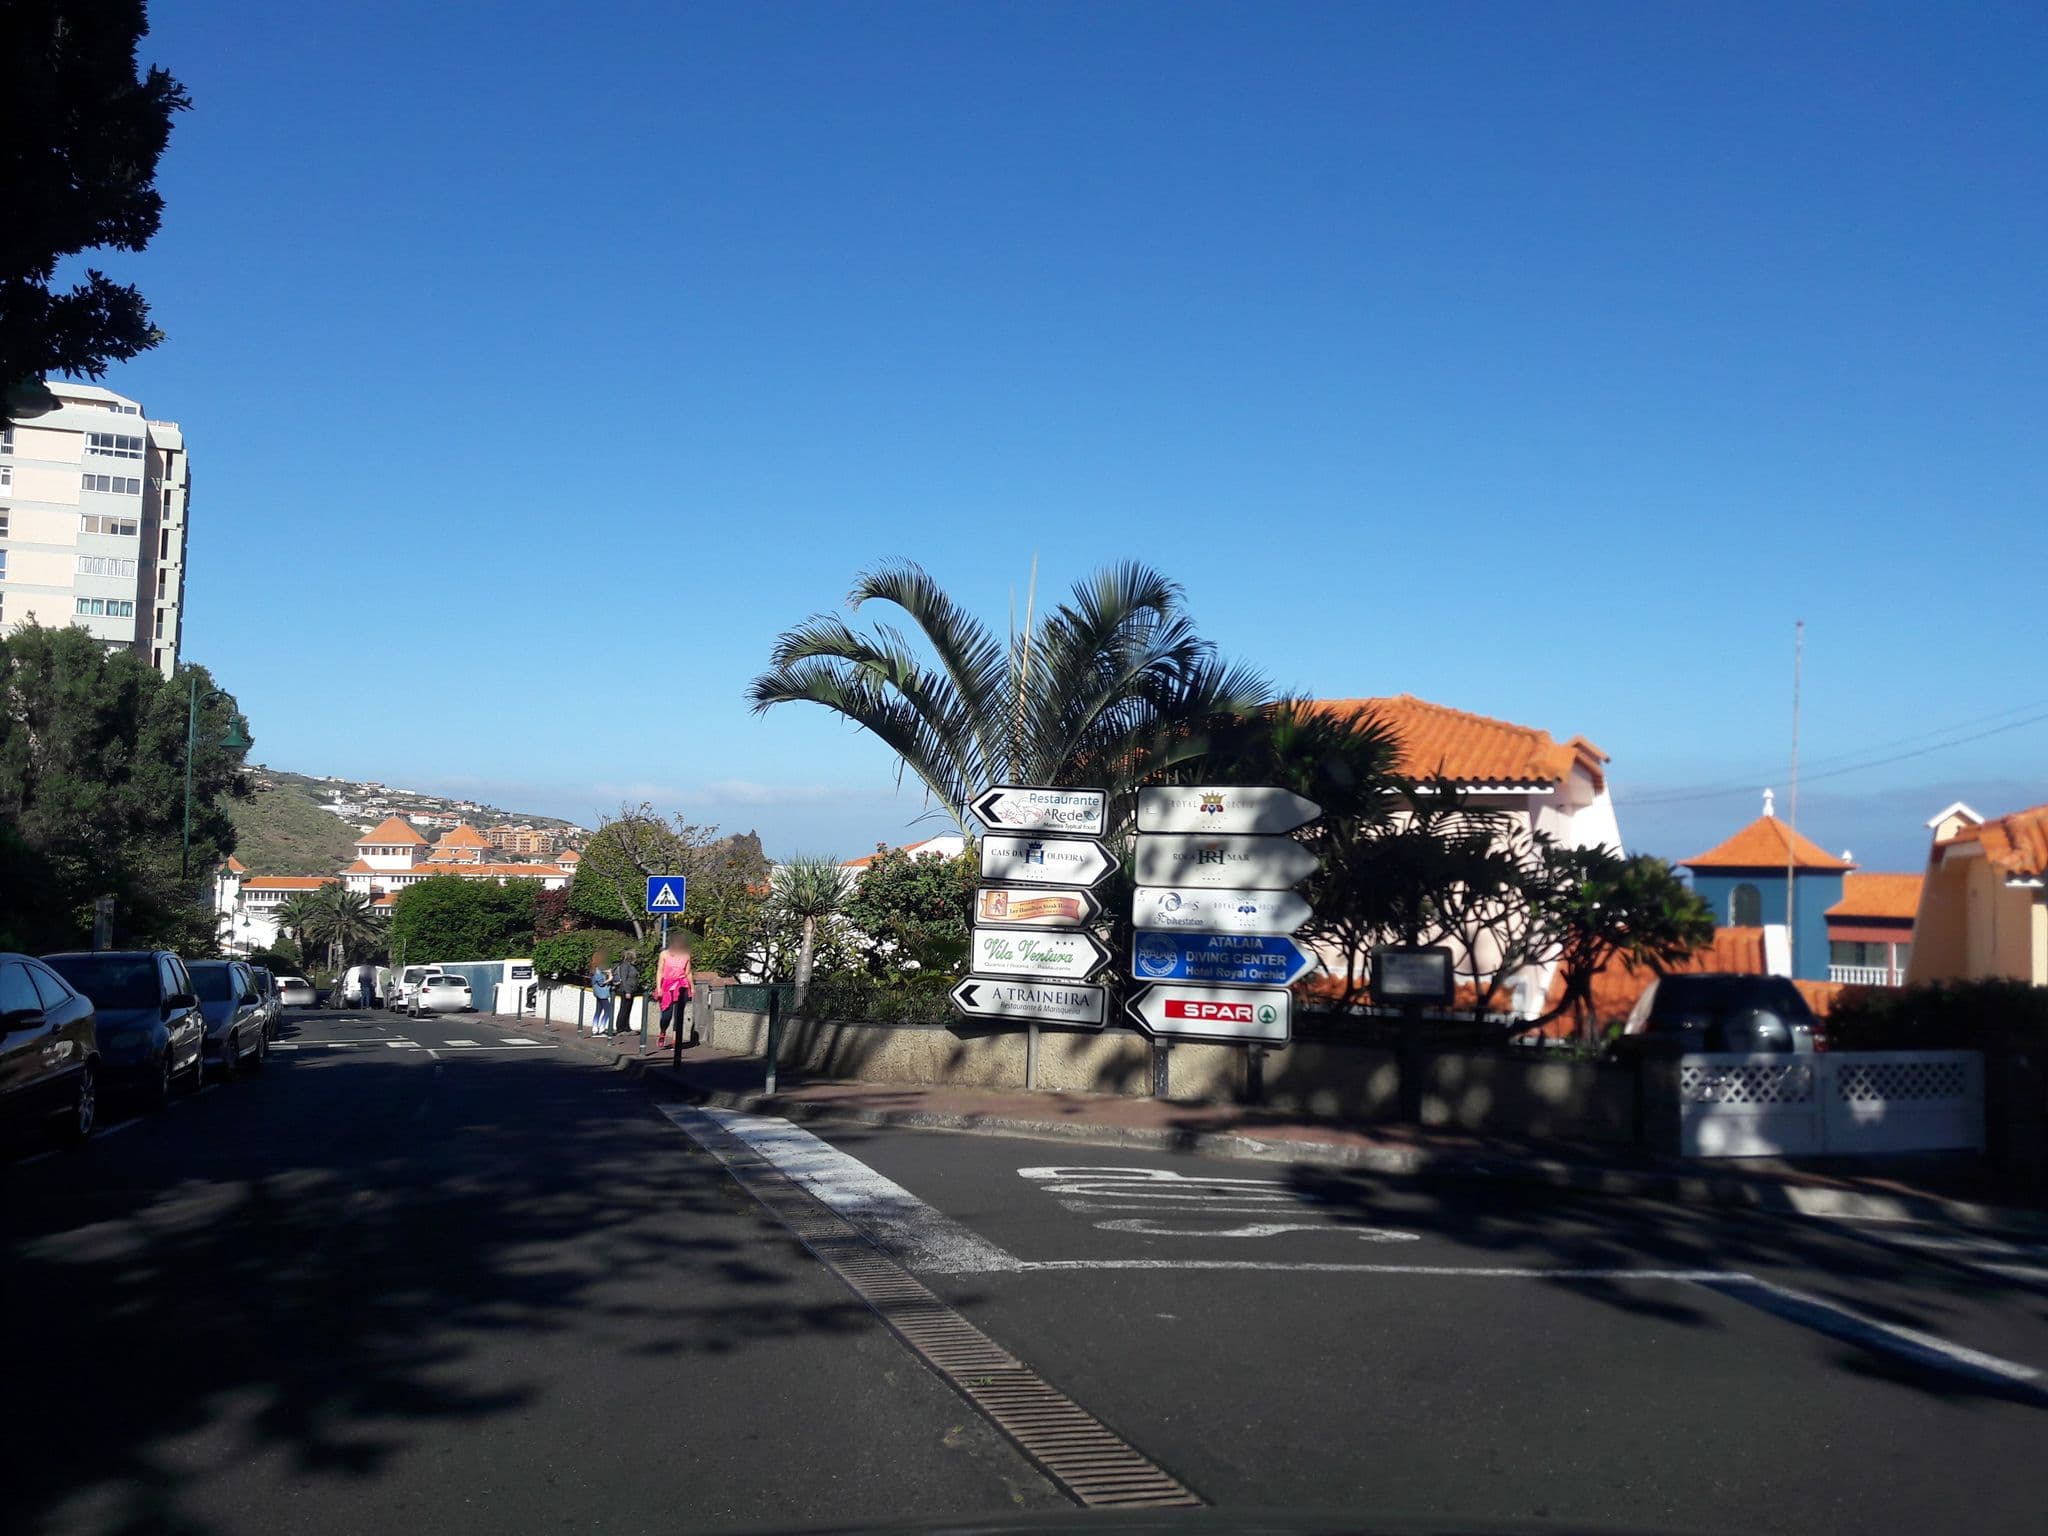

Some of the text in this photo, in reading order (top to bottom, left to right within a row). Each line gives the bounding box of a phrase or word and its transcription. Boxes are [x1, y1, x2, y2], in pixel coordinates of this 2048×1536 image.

[1029, 792, 1100, 806] Restaurante
[991, 848, 1084, 862] CAIS DA OLIVEIRA
[983, 937, 1075, 964] Vila Ventura
[1208, 936, 1264, 949] ATALAIA
[1185, 951, 1287, 967] DIVING CENTER
[1185, 965, 1213, 977] Hotel
[1215, 967, 1247, 981] Royal
[1248, 969, 1287, 981] Orchid
[992, 987, 1090, 1007] A TRAINEIRA
[1000, 1001, 1081, 1016] Restaurante & Marisqueira
[1183, 1003, 1253, 1020] SPAR
